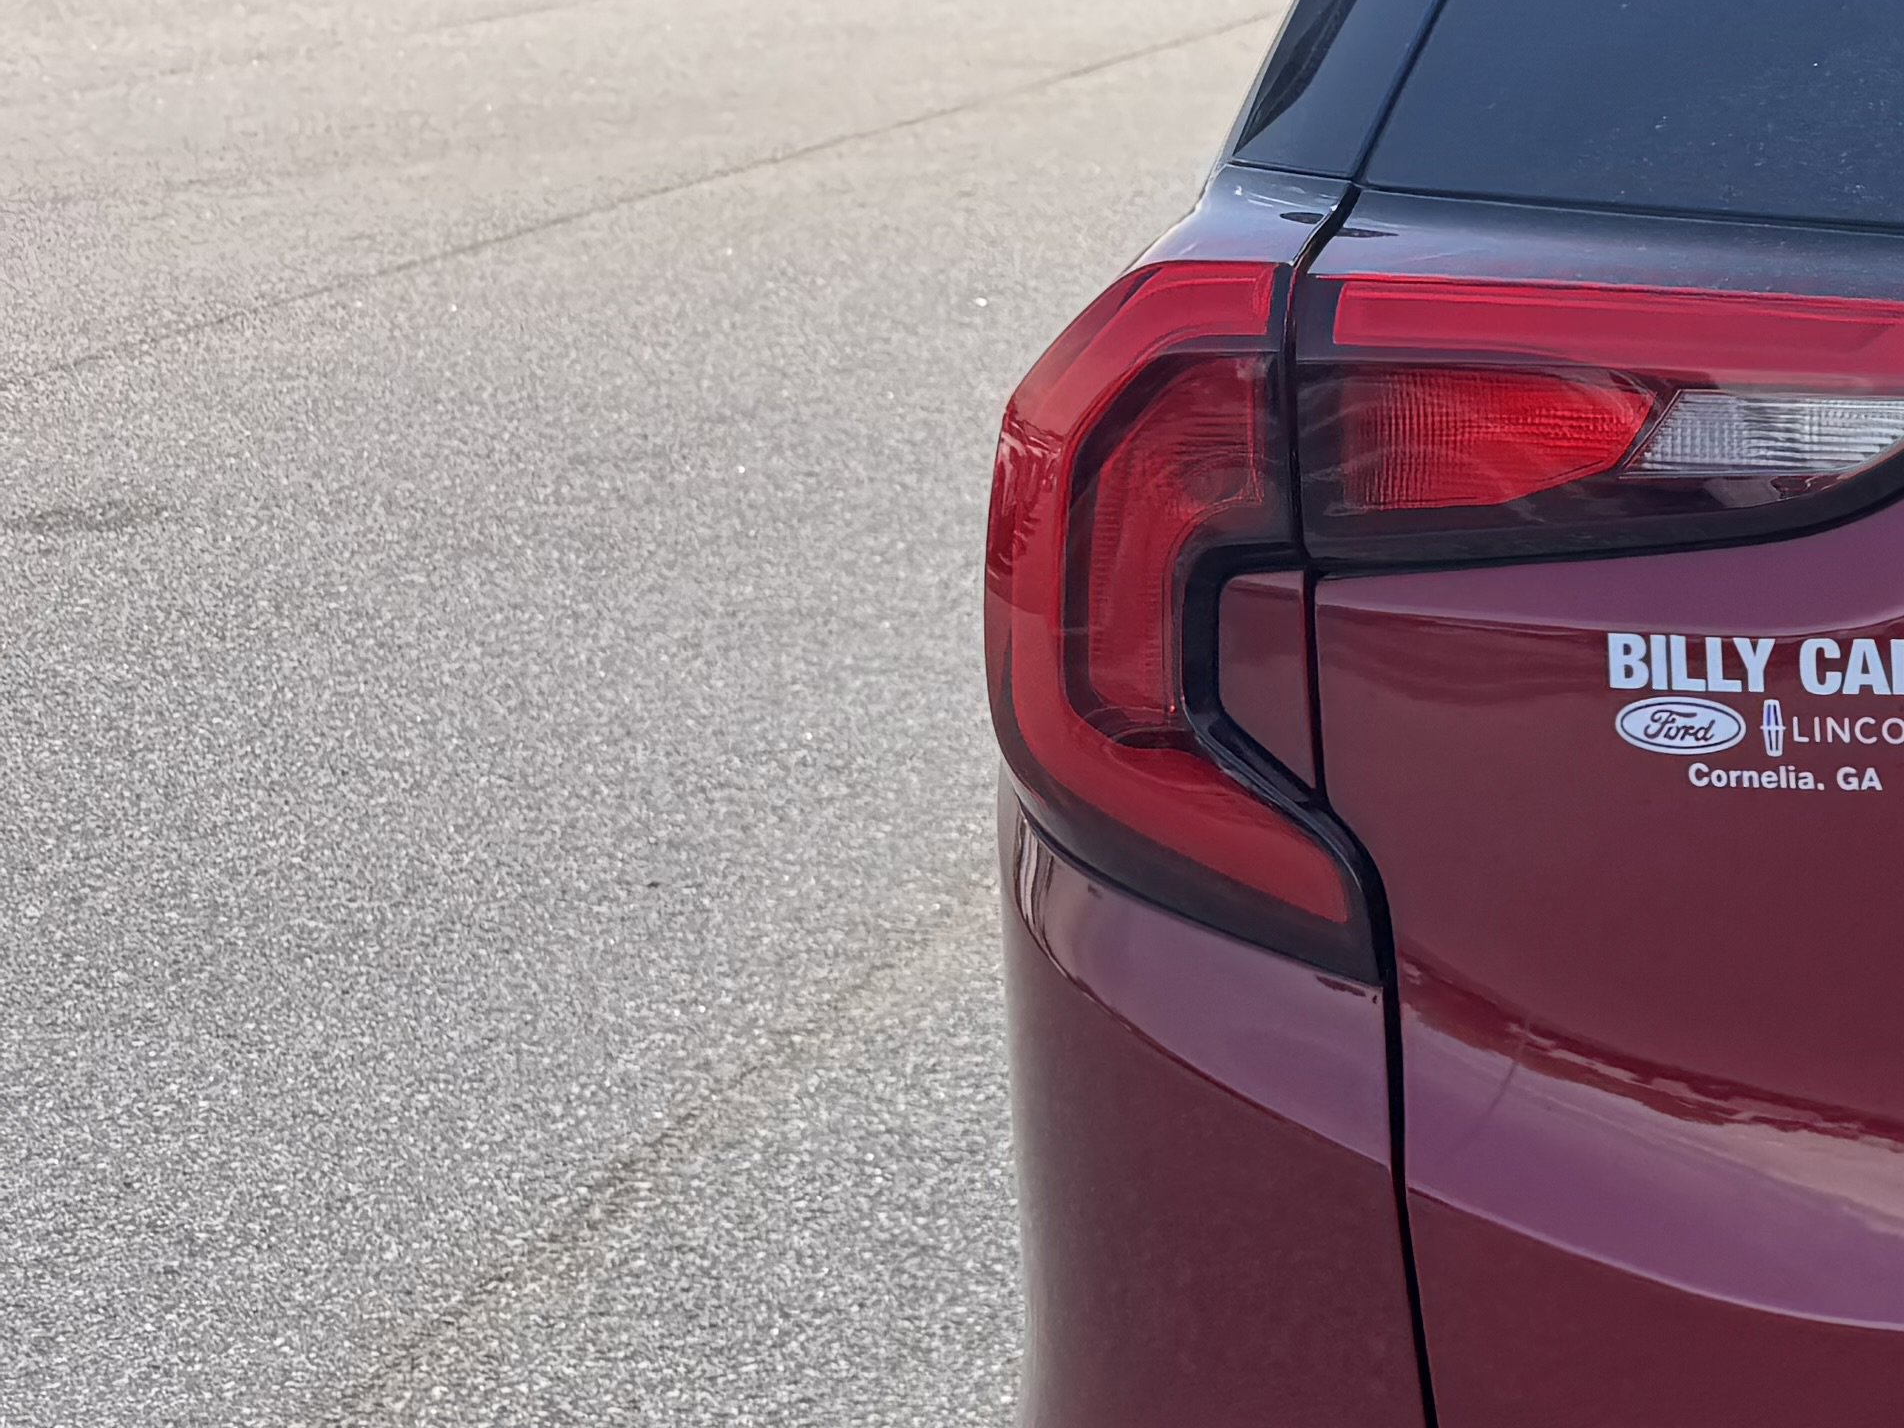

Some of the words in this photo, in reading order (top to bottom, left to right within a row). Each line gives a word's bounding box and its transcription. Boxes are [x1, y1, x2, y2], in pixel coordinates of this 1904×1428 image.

[1607, 632, 1776, 693] BILLY
[1643, 708, 1715, 743] Ford
[1836, 766, 1883, 791] GA
